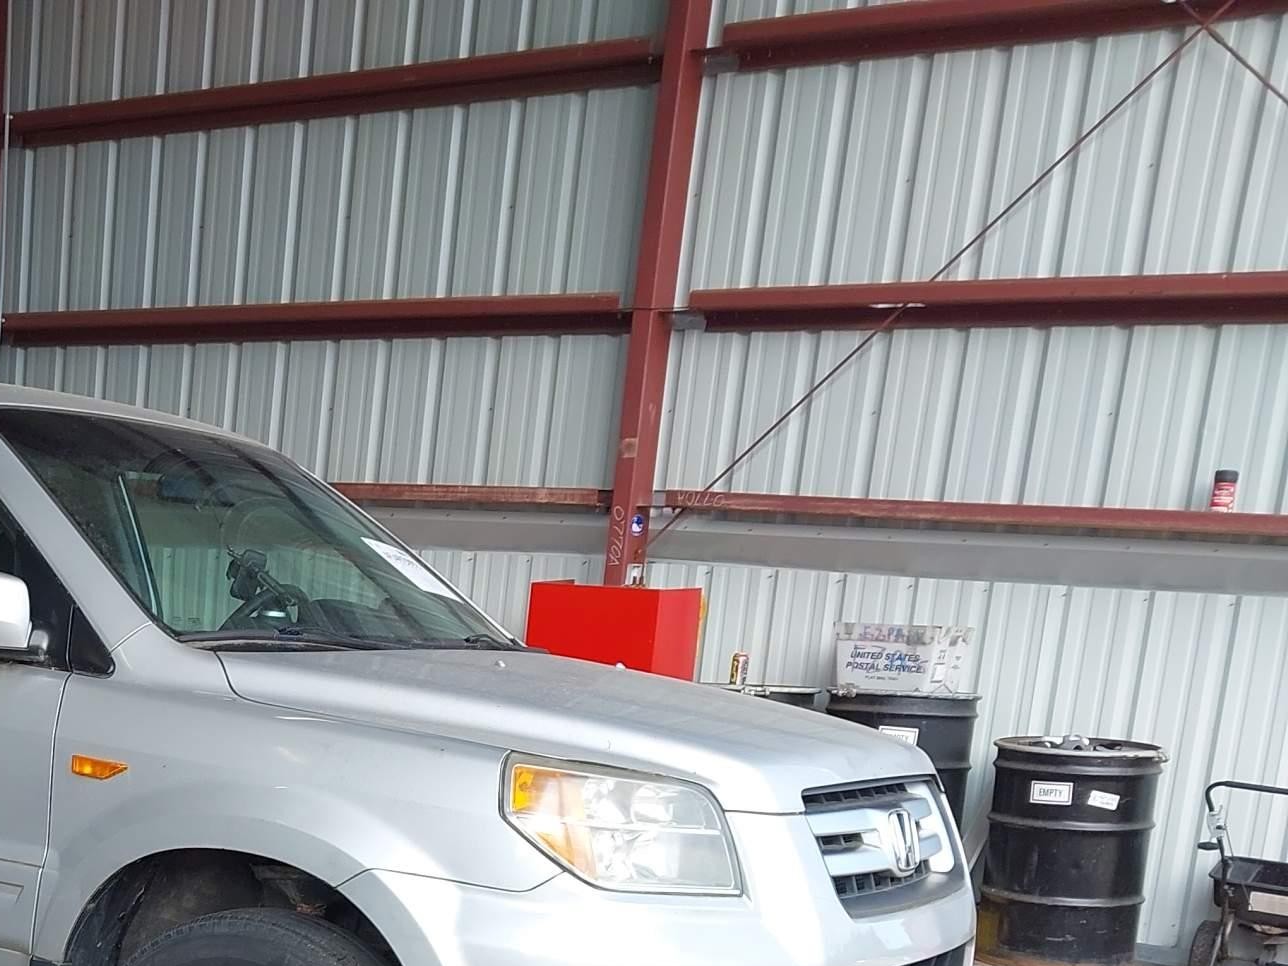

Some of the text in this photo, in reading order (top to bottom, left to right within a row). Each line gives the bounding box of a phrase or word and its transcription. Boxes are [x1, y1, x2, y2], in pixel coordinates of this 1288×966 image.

[851, 650, 921, 663] UNITED STATES
[846, 661, 922, 674] POSTAL SERVICE
[1038, 788, 1063, 797] EMPTY
